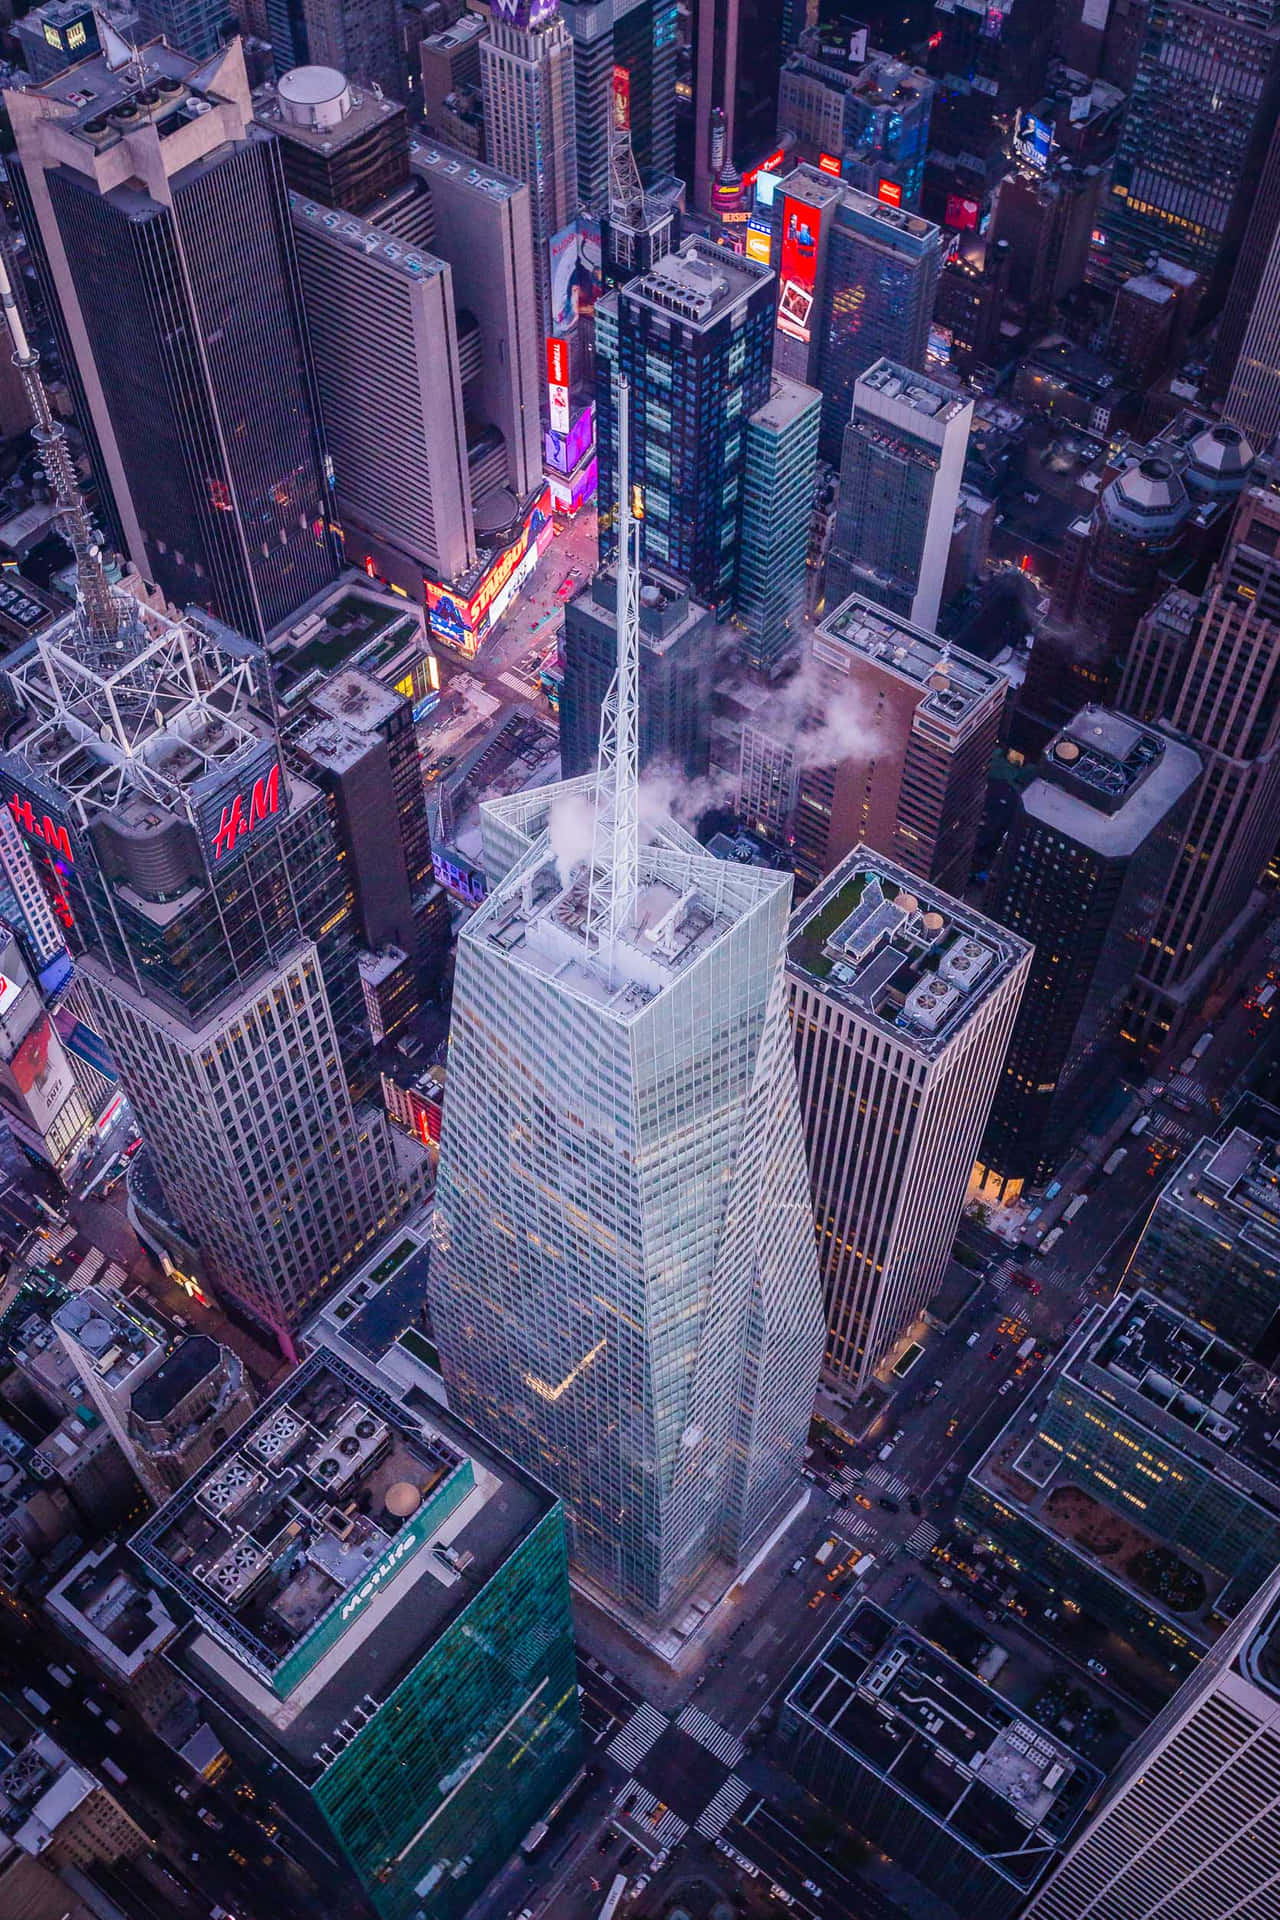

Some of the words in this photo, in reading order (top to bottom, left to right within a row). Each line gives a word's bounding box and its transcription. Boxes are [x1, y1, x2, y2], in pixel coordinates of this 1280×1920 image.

[712, 127, 724, 169] HERSHEY'S
[471, 526, 530, 623] STARBOY
[8, 793, 73, 863] H&M
[211, 763, 279, 860] H&M
[342, 1534, 416, 1620] MetLife
